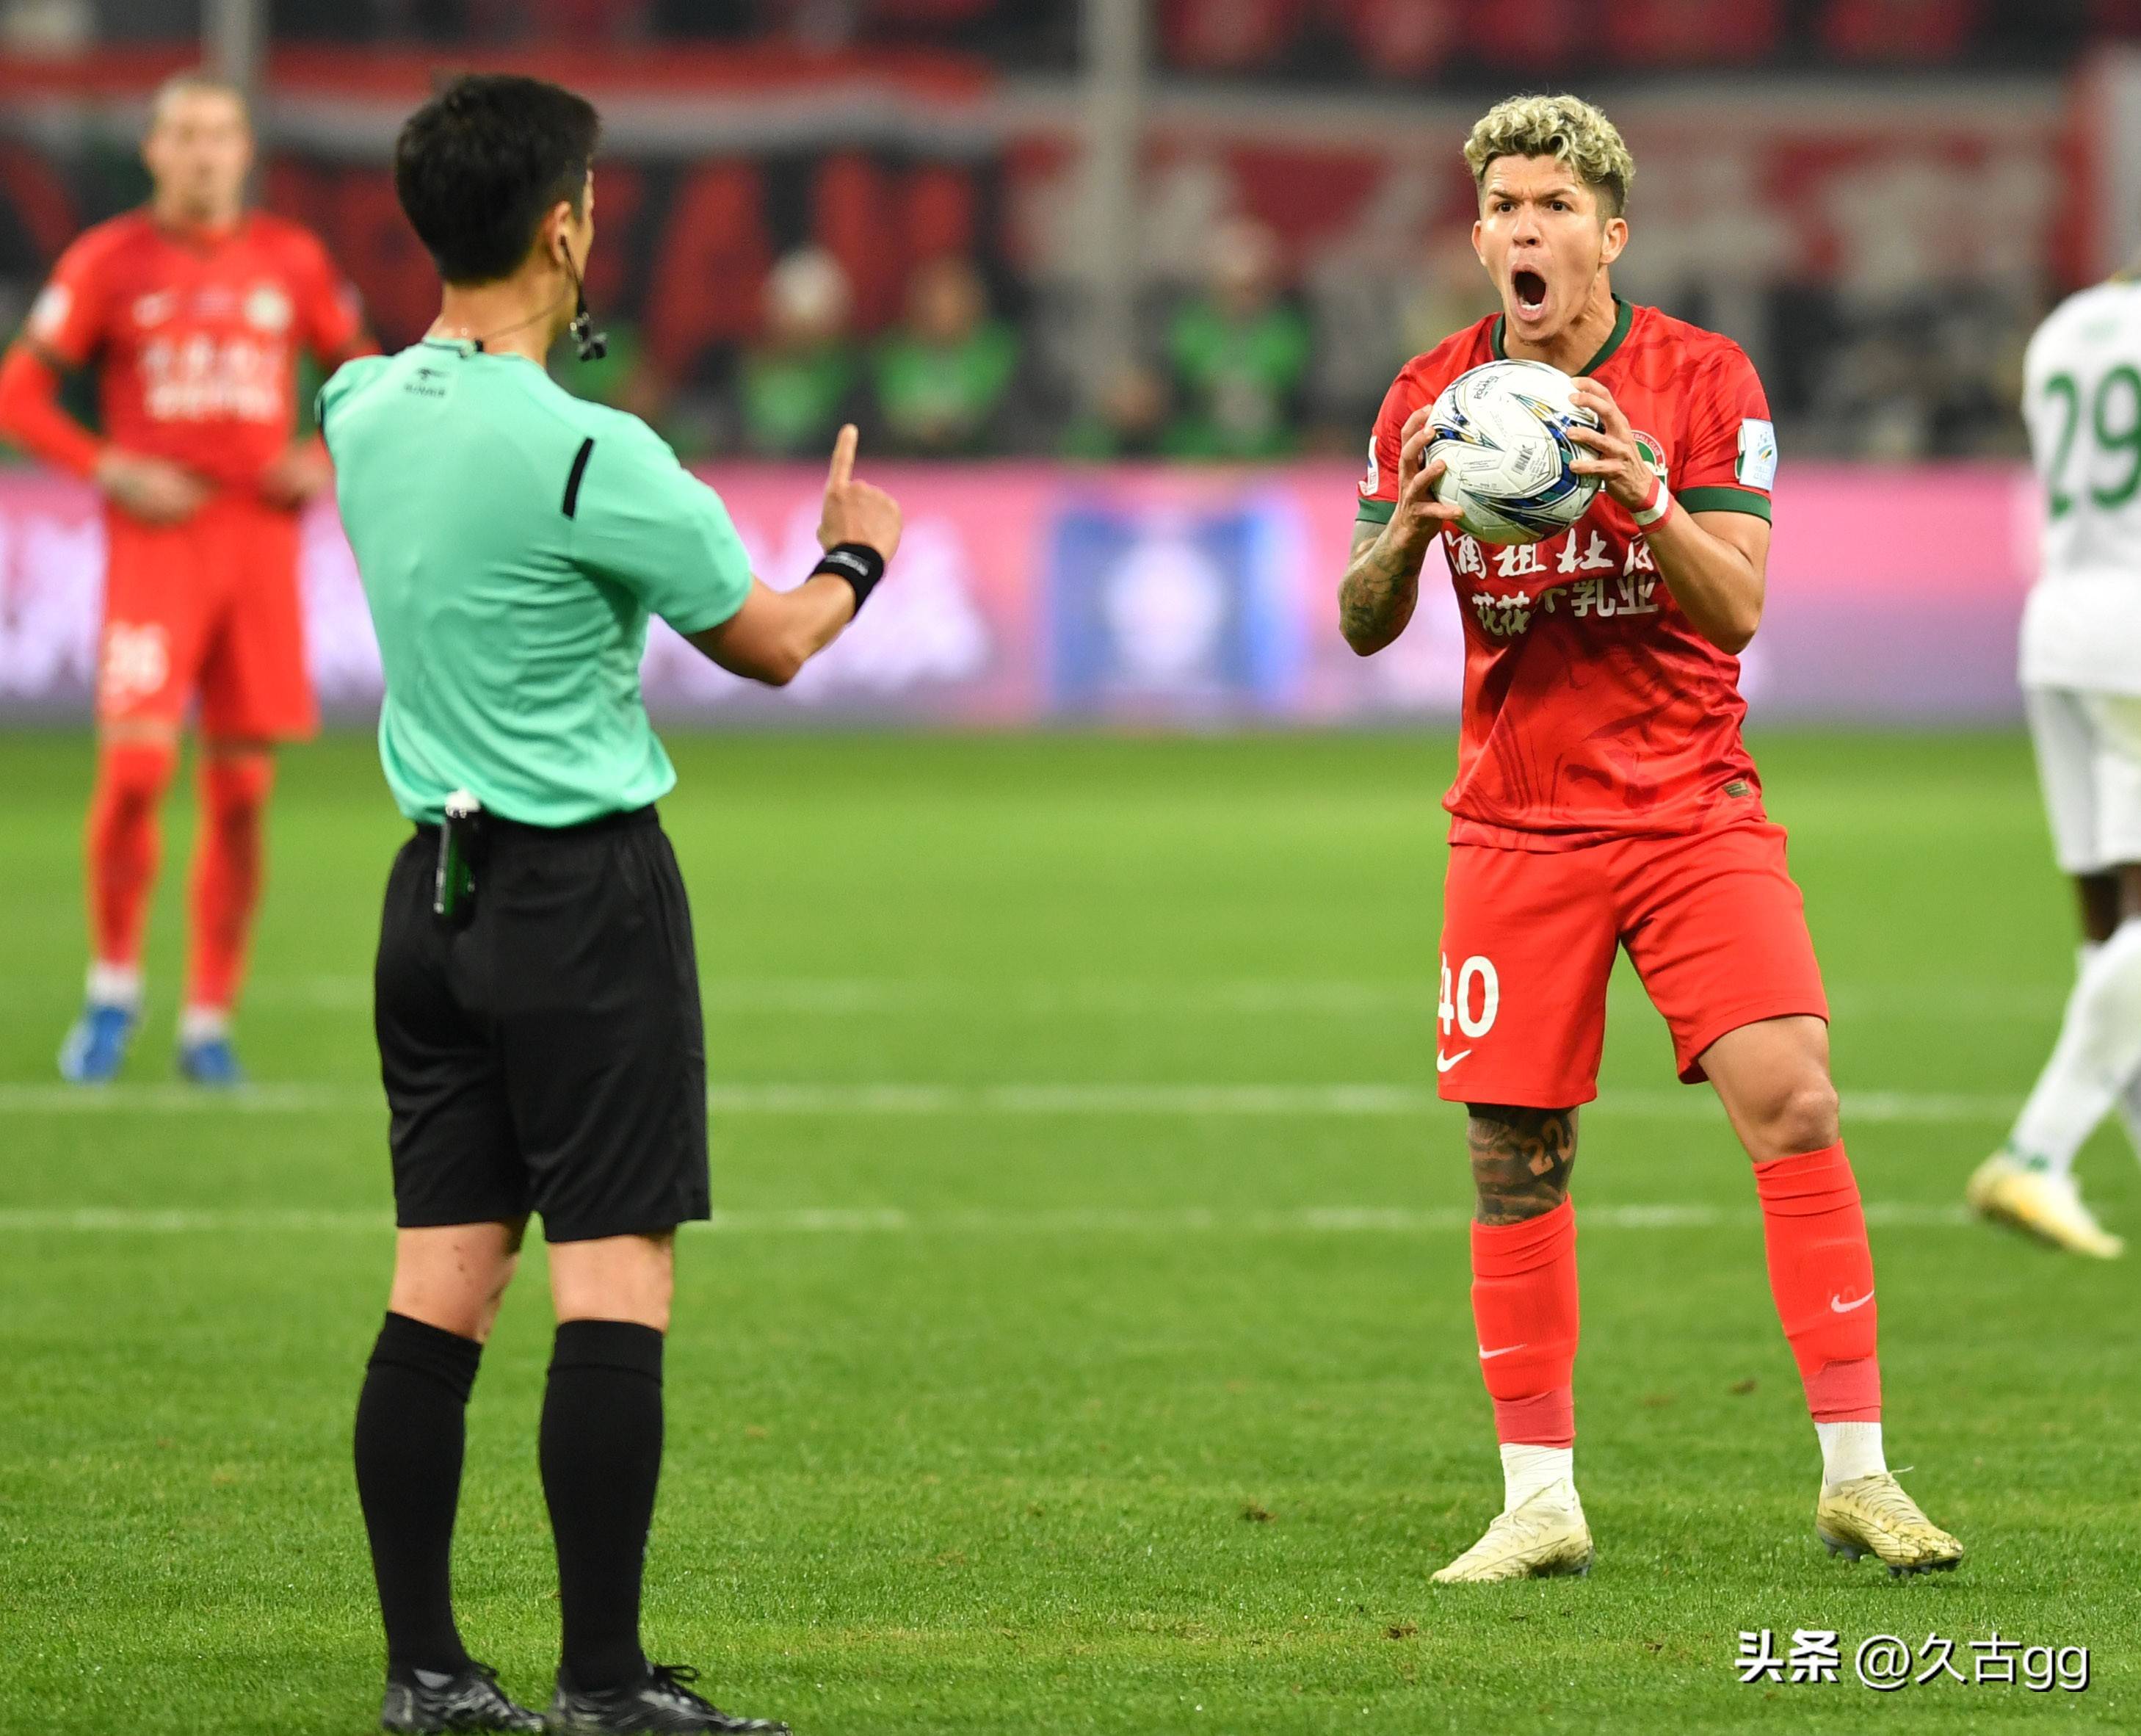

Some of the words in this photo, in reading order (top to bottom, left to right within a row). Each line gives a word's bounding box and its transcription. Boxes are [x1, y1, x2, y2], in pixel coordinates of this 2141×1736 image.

[1649, 441, 1661, 456] CLUB
[2043, 364, 2141, 524] 29
[1438, 951, 1499, 1038] 40
